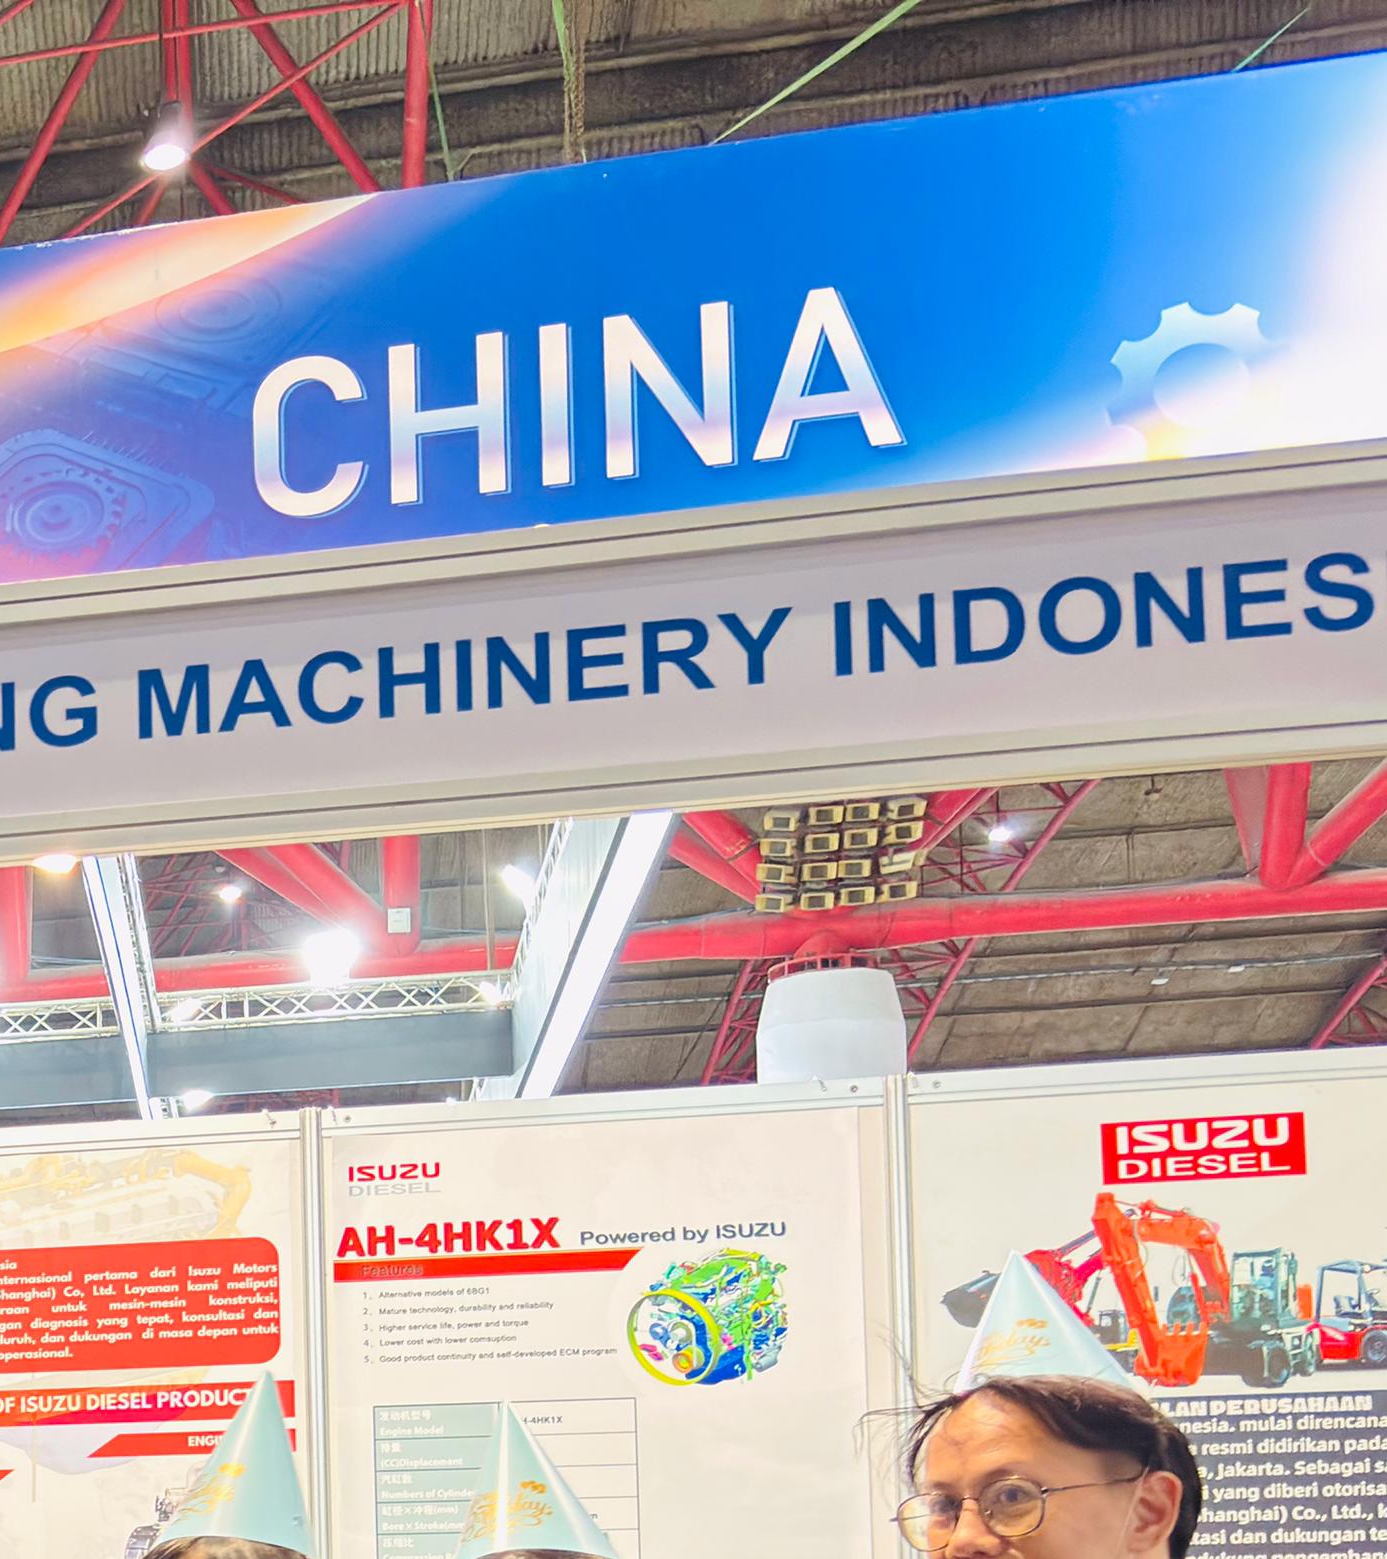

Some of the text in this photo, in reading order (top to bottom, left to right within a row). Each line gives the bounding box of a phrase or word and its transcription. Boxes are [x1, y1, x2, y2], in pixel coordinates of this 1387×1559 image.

[253, 287, 908, 517] CHINA
[137, 606, 793, 740] MACHINERY
[833, 552, 1375, 677] INDONES
[1116, 1118, 1290, 1155] ISUZU
[348, 1162, 441, 1182] ISUZU
[1117, 1153, 1291, 1180] DIESEL
[348, 1182, 443, 1197] DIESEL
[336, 1216, 787, 1257] AH-4HK1X Powered by ISUZU
[84, 1269, 138, 1284] pertama
[149, 1267, 176, 1279] dari
[188, 1265, 221, 1277] Isuzu
[233, 1263, 277, 1275] Motors
[361, 1264, 423, 1277] Features
[63, 1286, 85, 1302] Co,
[93, 1285, 116, 1297] Ltd.
[125, 1283, 179, 1298] Layanan
[187, 1281, 219, 1293] kami
[227, 1278, 277, 1294] meliputi
[51, 1301, 87, 1314] untuk
[109, 1298, 187, 1311] mesin-mesin
[209, 1294, 278, 1310] konstruksi,
[30, 1316, 89, 1332] diagnosis
[96, 1317, 128, 1330] yang
[136, 1313, 174, 1328] tepat,
[182, 1310, 245, 1323] konsultasi
[253, 1308, 278, 1320] dan
[40, 1332, 65, 1344] dan
[69, 1329, 132, 1345] dukungan
[142, 1328, 154, 1340] di
[159, 1329, 193, 1339] masa
[197, 1325, 238, 1340] depan
[242, 1323, 279, 1335] untuk
[20, 1394, 81, 1412] ISUZU
[86, 1392, 152, 1410] DIESEL
[157, 1388, 253, 1408] PRODUCT
[1239, 1416, 1293, 1432] mulai
[1202, 1437, 1340, 1455] resmi didirikan
[1217, 1458, 1371, 1479] Jakarta. Sebagai
[1213, 1482, 1319, 1502] yang diberi
[1291, 1504, 1374, 1522] Co., Ltd.,
[1230, 1526, 1367, 1547] dan dukungan
